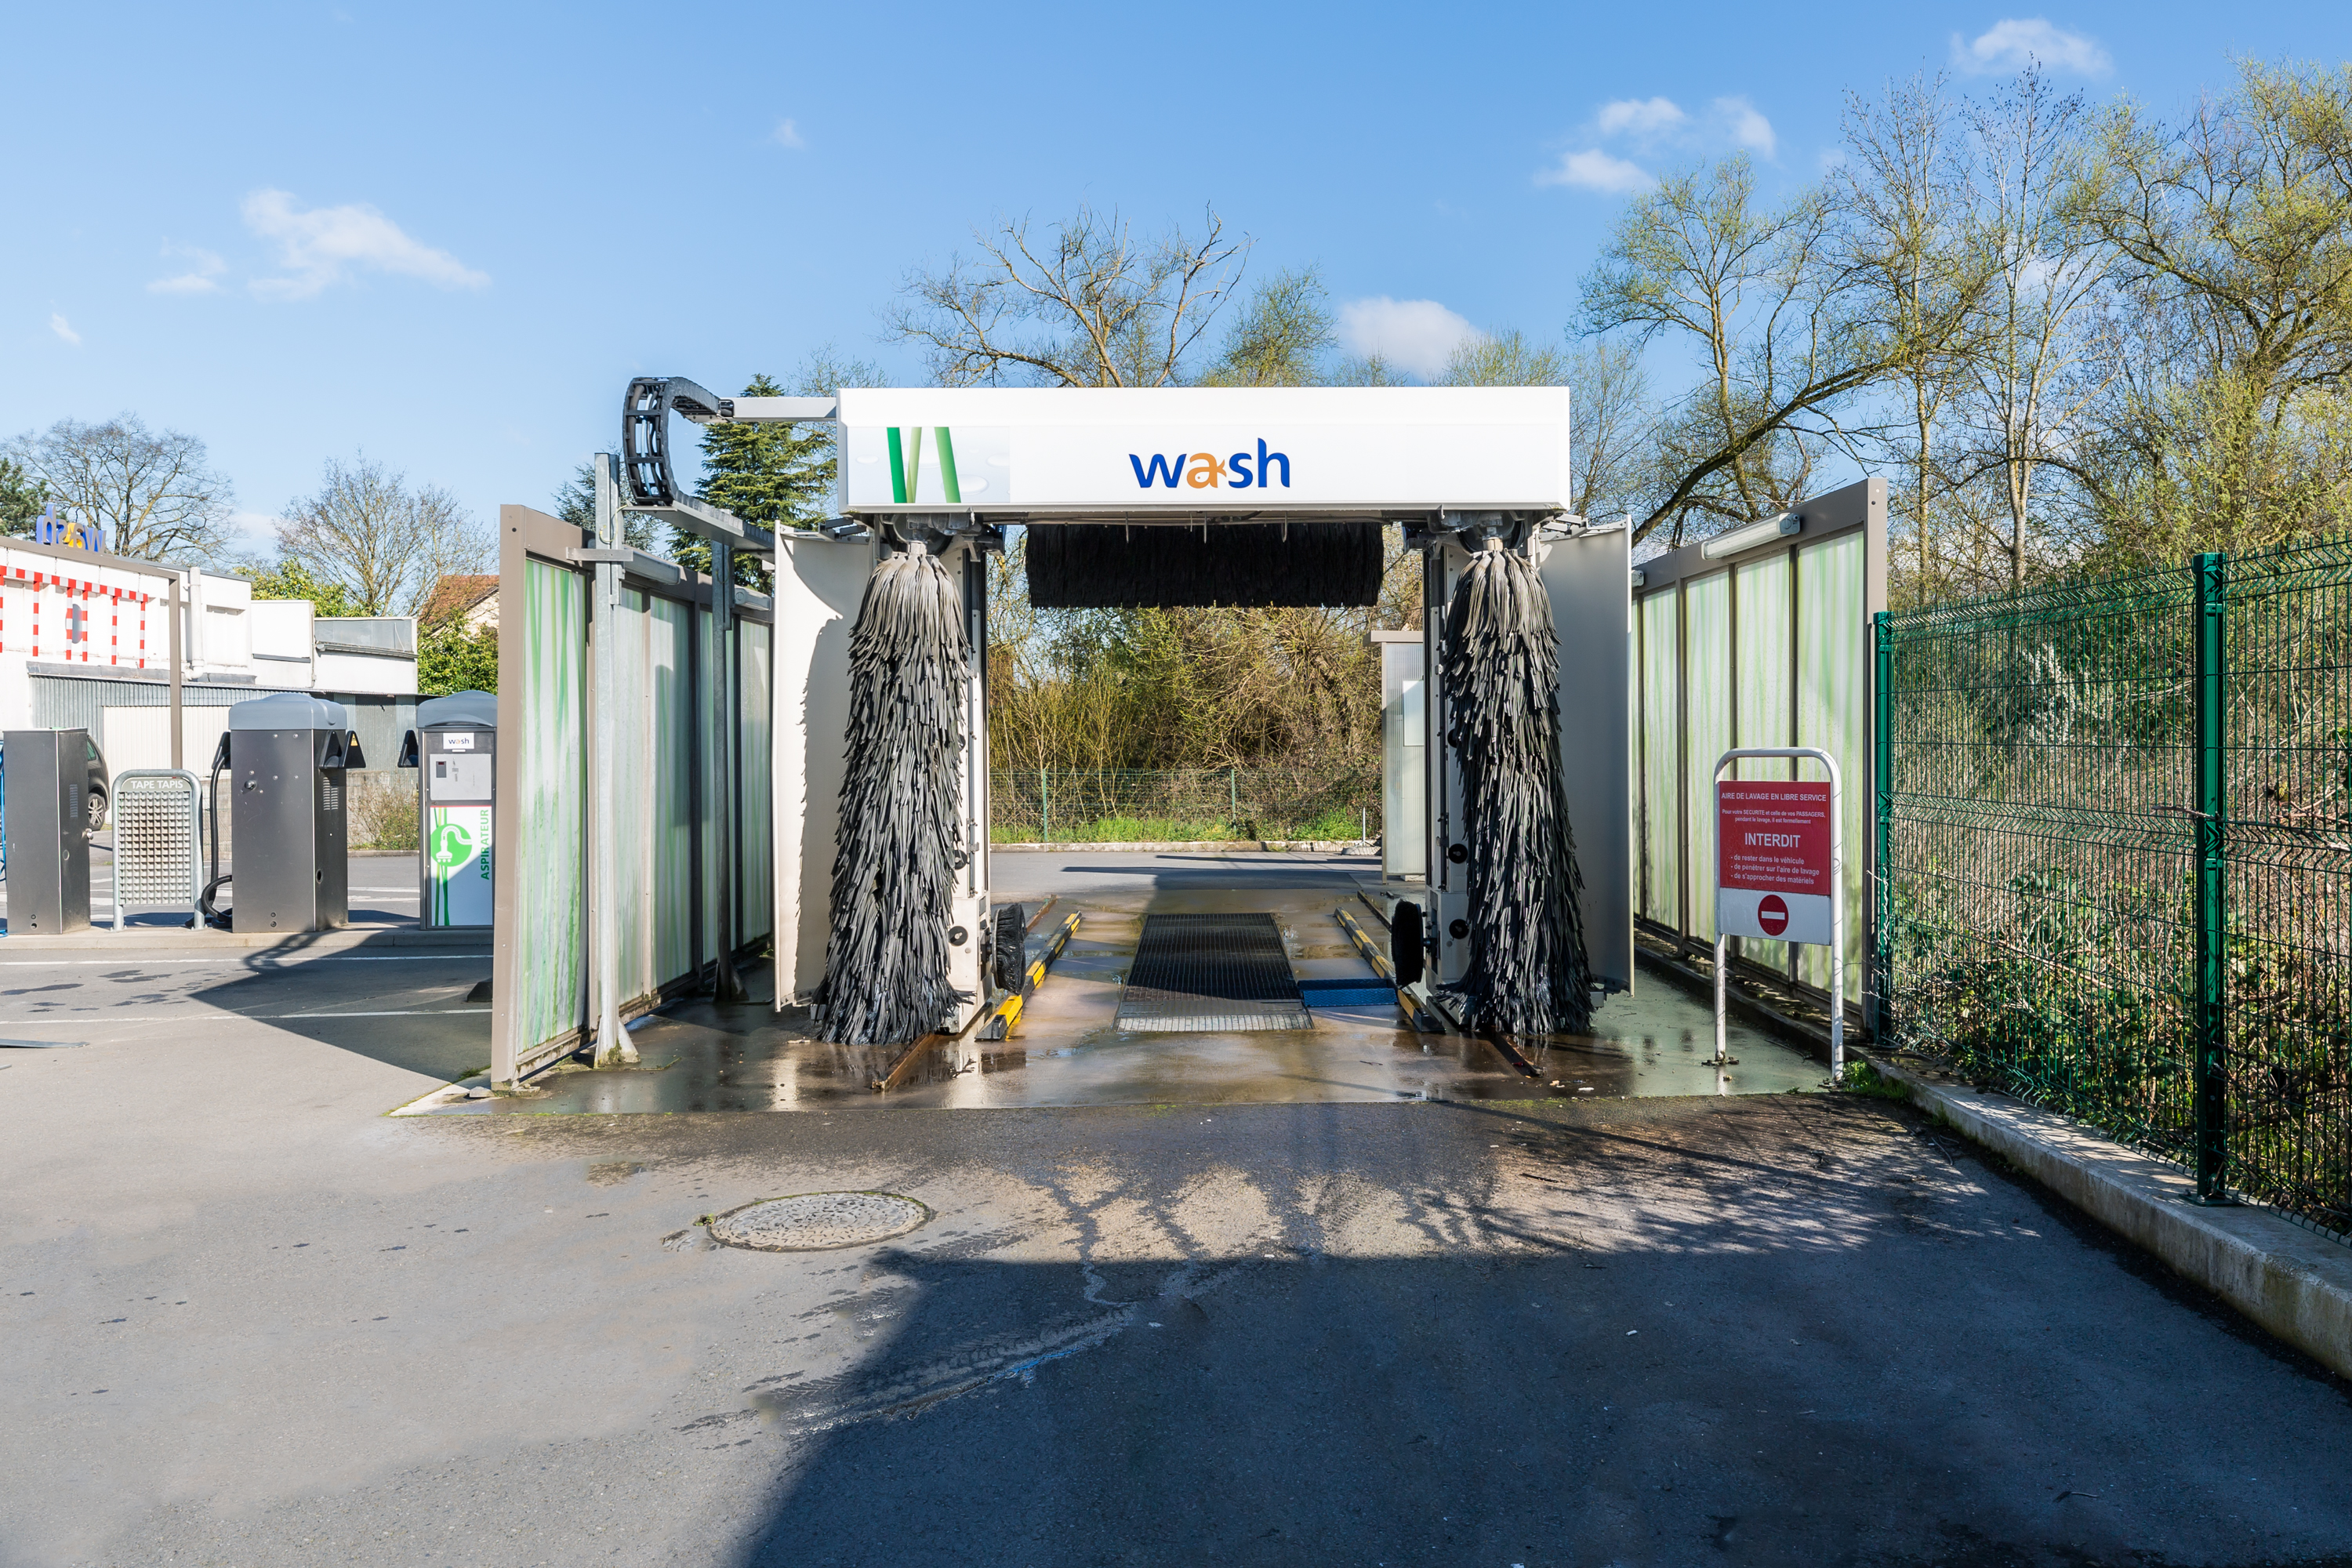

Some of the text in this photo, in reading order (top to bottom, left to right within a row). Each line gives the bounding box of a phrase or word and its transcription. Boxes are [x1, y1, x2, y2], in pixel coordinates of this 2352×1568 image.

[1128, 437, 1290, 488] wash
[131, 780, 183, 789] TAPE TAPIS
[480, 809, 490, 880] ASPIRATEUR
[1745, 833, 1801, 848] INTERDIT
[1800, 867, 1820, 877] lavage
[1788, 876, 1814, 884] matériels
